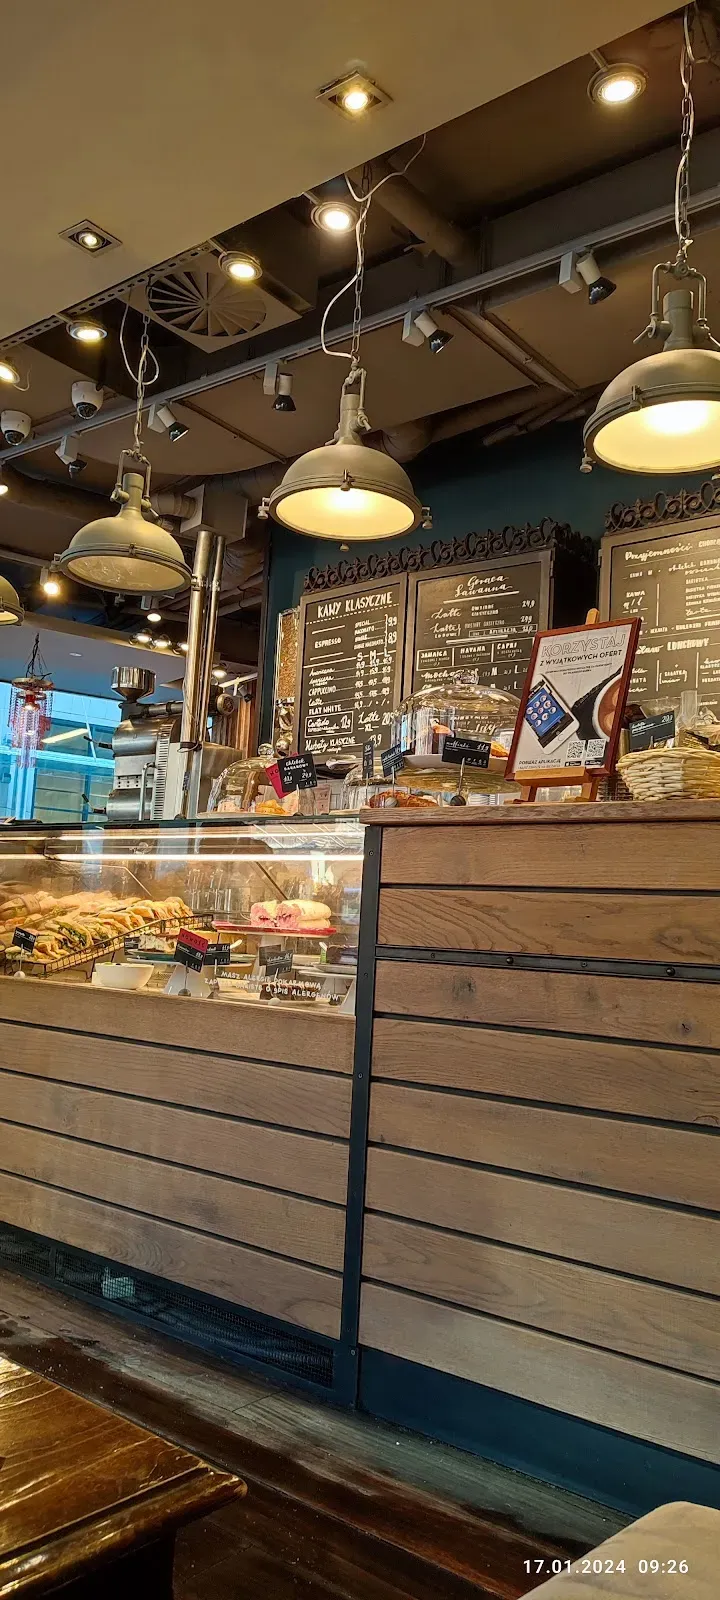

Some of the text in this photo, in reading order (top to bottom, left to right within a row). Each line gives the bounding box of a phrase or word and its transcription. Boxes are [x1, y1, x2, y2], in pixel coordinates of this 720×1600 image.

[317, 591, 393, 618] KAWY KLASYCZNE
[314, 637, 342, 649] ESPRESSO
[496, 641, 518, 651] CAPRI
[541, 634, 626, 659] KORZYSTAJ
[356, 647, 391, 661] S M L
[420, 650, 448, 660] JAMAICA
[460, 645, 487, 655] HAVANA
[539, 649, 623, 667] Z WYJĄTKOWYCH OFERT
[308, 707, 322, 715] FLAT
[323, 703, 342, 713] WHITE
[358, 711, 381, 724] Latte
[364, 723, 374, 732] XL
[329, 736, 356, 748] KLASYCZNE
[221, 971, 240, 980] MASZ
